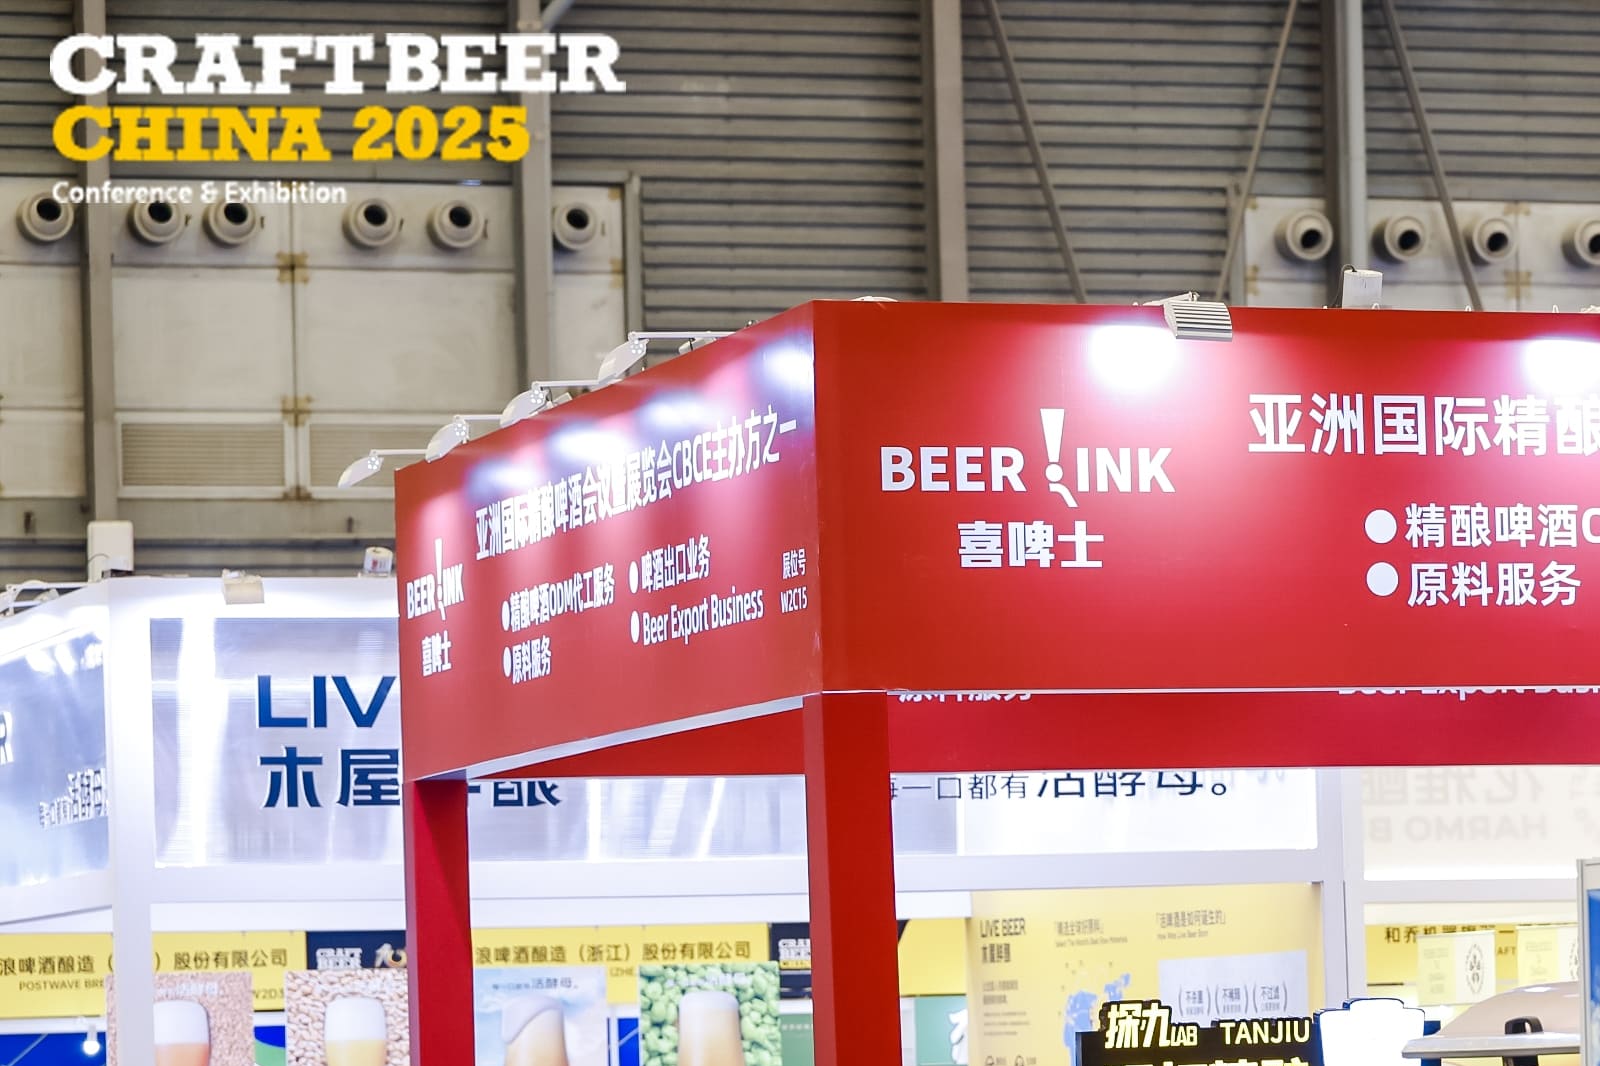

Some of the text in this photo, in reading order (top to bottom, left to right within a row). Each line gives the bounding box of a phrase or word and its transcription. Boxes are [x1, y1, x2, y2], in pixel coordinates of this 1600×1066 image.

[880, 446, 1026, 493] BEER
[641, 534, 711, 592] 啤酒出口业务
[782, 549, 806, 580] 展位号
[957, 520, 1105, 569] 喜啤士
[406, 576, 436, 620] BEER
[509, 563, 615, 632] 精酿啤酒ODM代工服务
[780, 589, 808, 614] W2C15
[1407, 560, 1581, 607] 原料服务
[642, 589, 763, 646] Beer Export Business
[422, 630, 452, 677] 喜啤士
[512, 635, 551, 685] 原料服务
[1001, 917, 1026, 936] BEER
[1219, 1020, 1311, 1045] TANJIU
